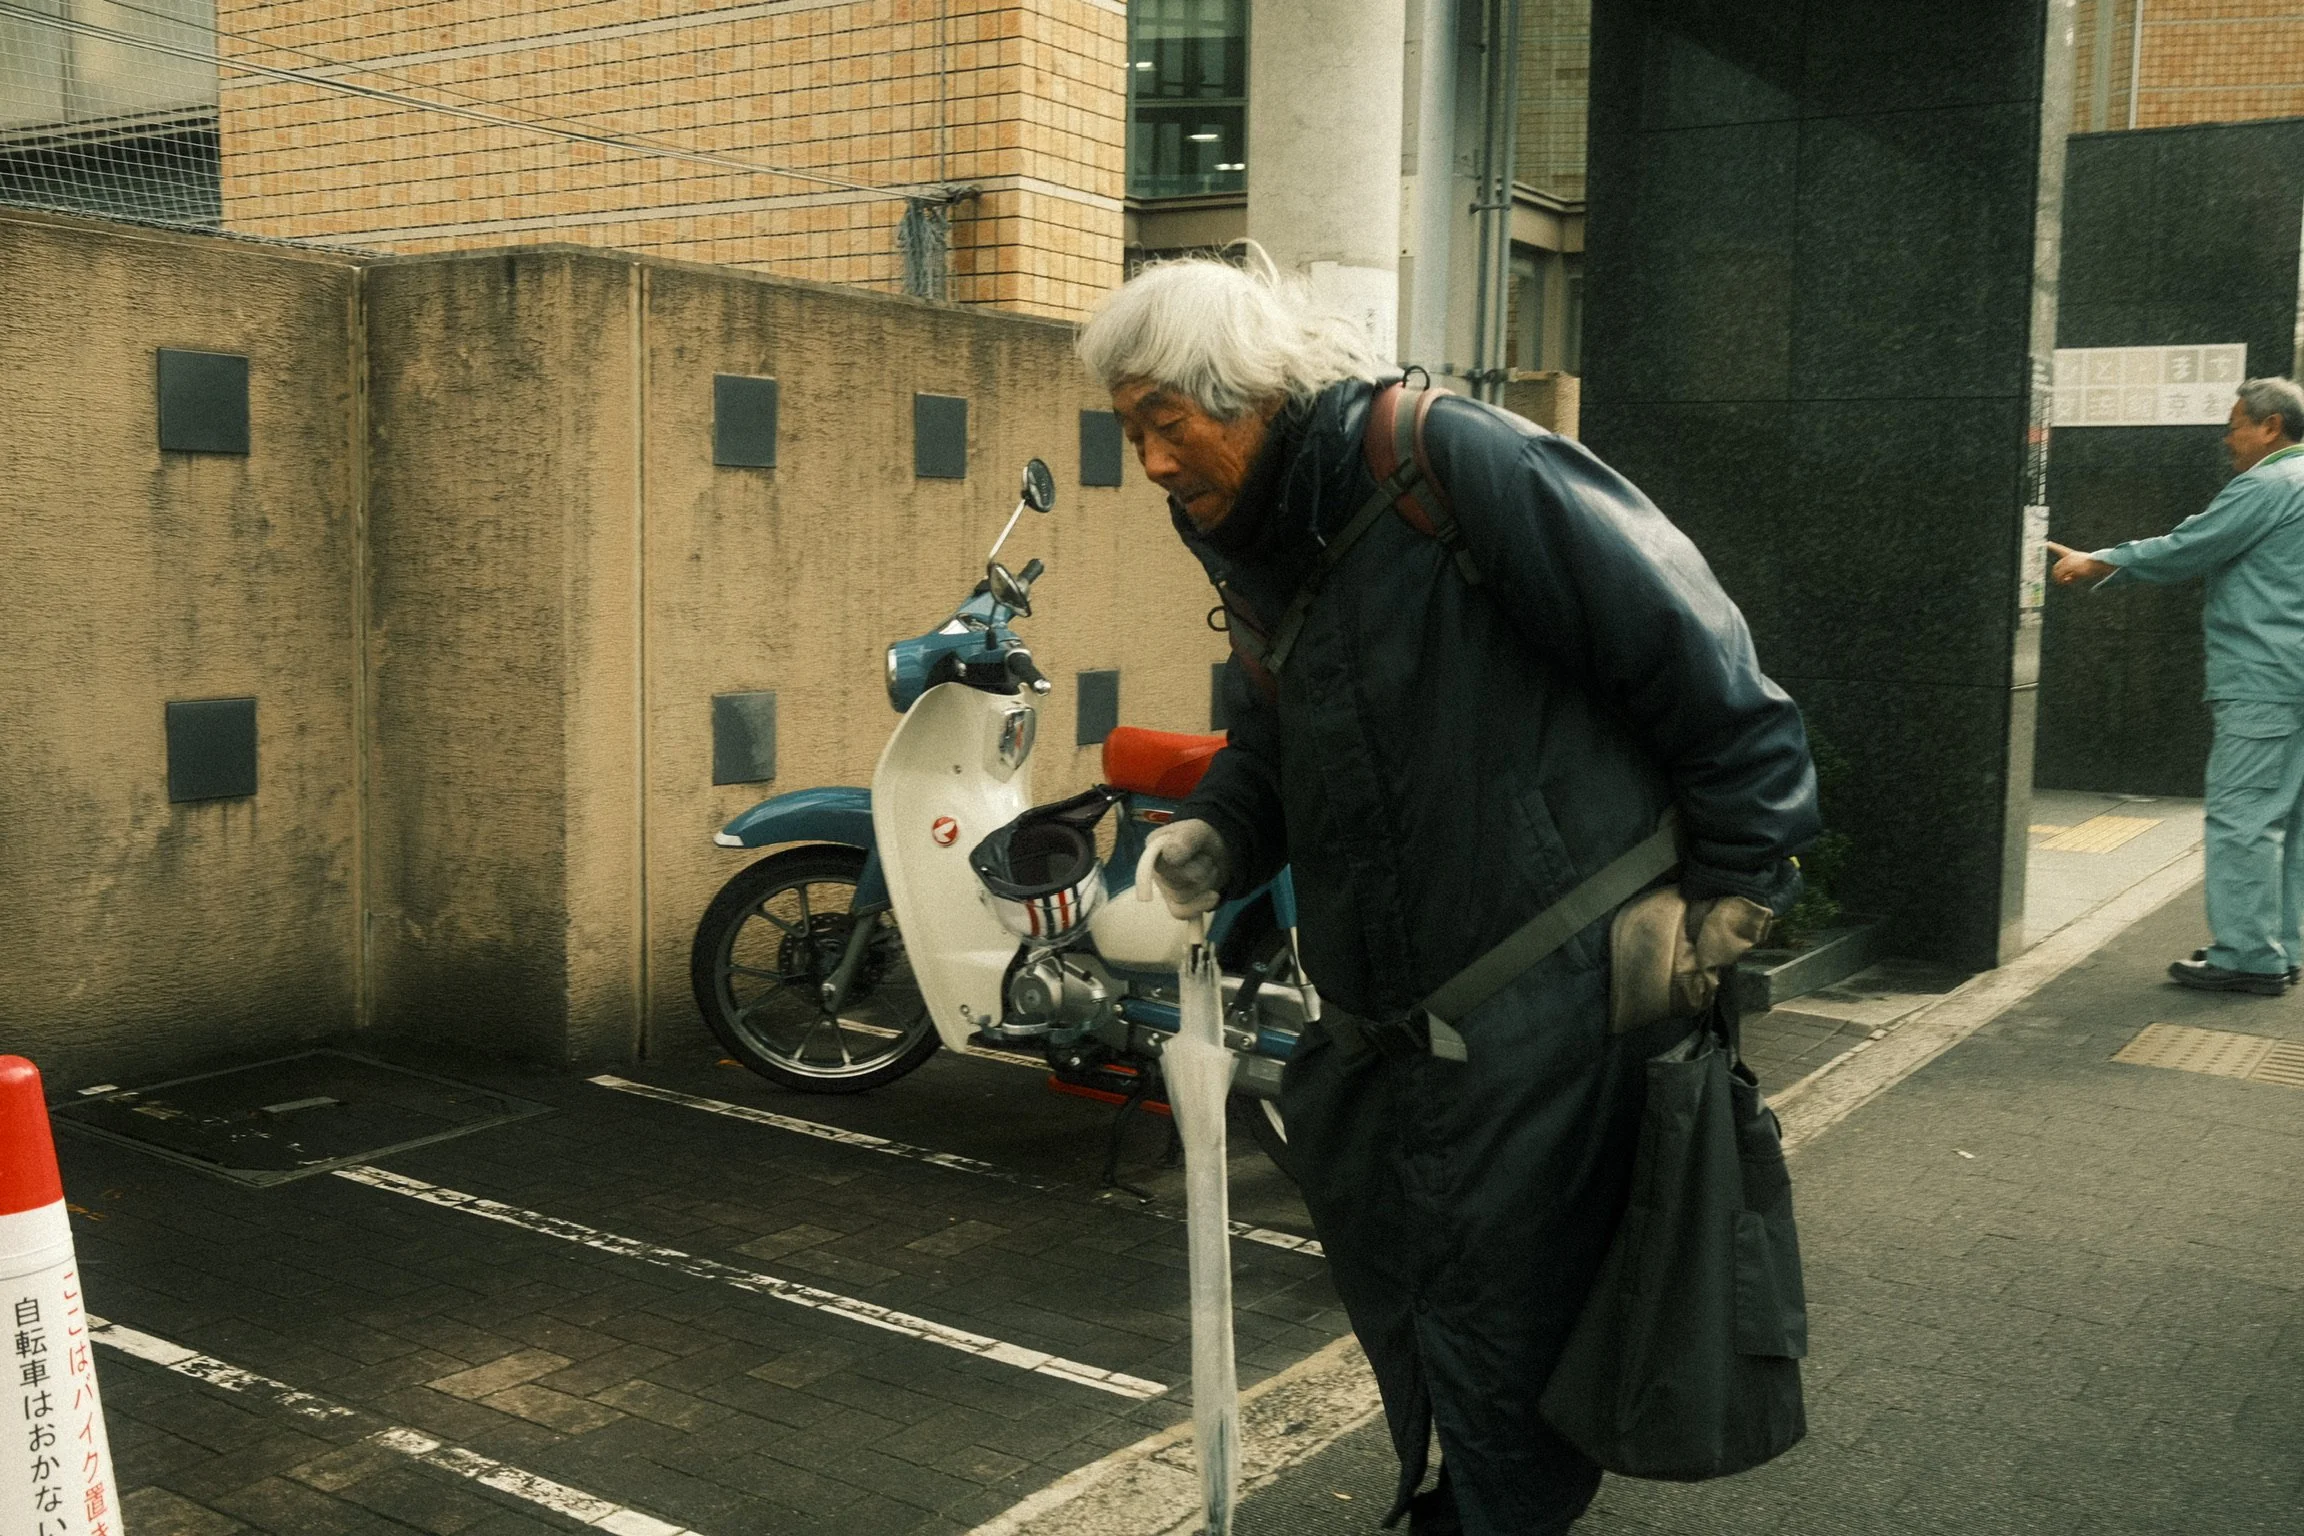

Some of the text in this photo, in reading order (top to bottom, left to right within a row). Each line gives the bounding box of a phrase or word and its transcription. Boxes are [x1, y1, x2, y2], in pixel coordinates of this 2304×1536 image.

[14, 1297, 66, 1536] 自転車はおかない
